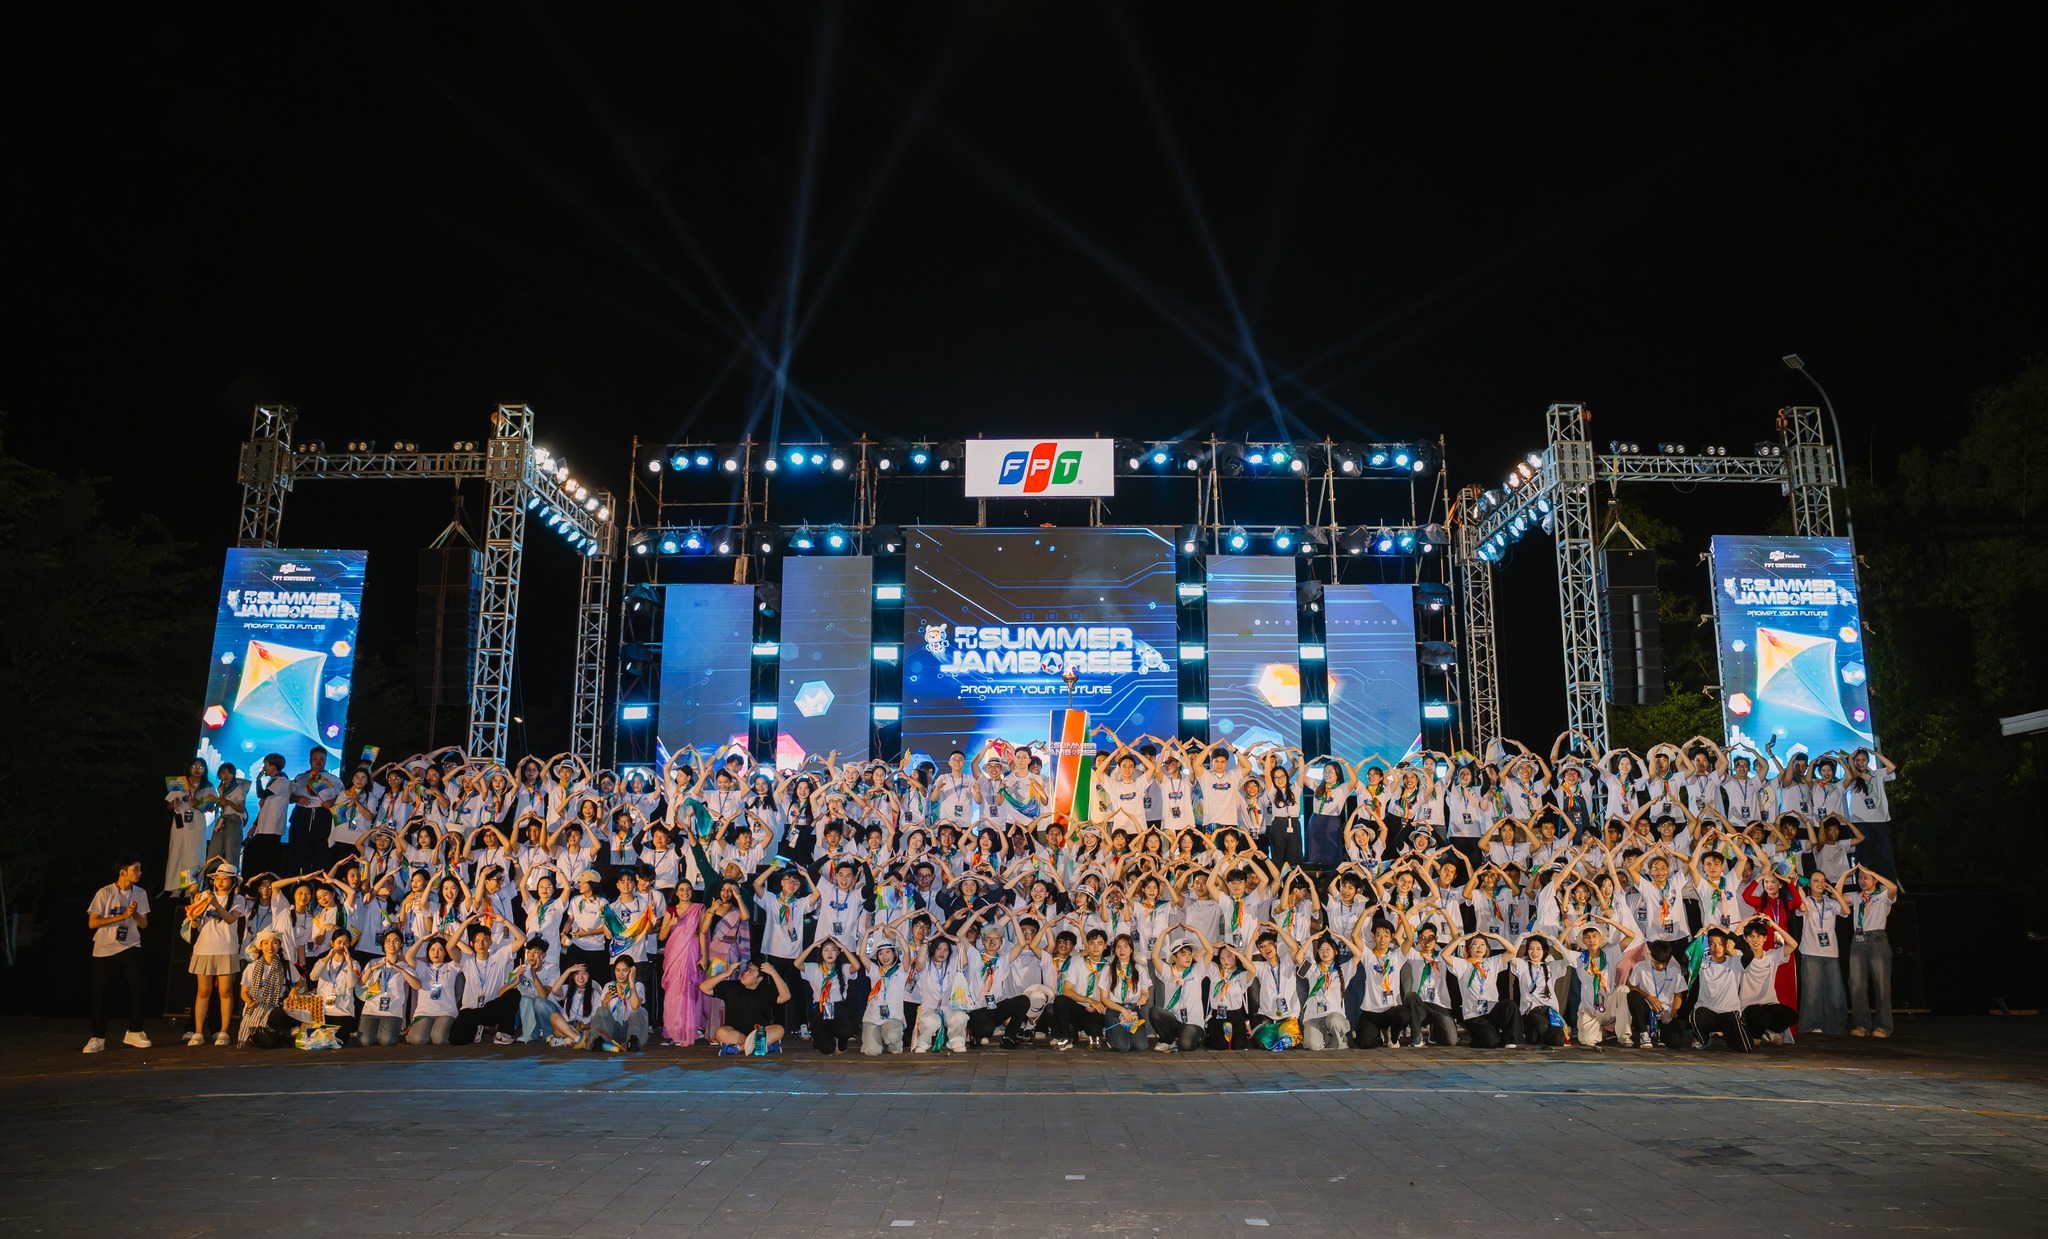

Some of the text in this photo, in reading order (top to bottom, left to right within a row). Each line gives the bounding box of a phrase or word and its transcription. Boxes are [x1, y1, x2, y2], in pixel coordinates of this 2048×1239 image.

[1754, 579, 1836, 592] SUMMER
[257, 591, 341, 605] SUMMER
[1735, 591, 1838, 605] JAMBOREE
[234, 604, 340, 619] JAMBOREE
[978, 627, 1133, 650] SUMMER
[940, 650, 1133, 675] JAMBOREE
[960, 685, 1112, 694] PROMPT YOUR FUTURE
